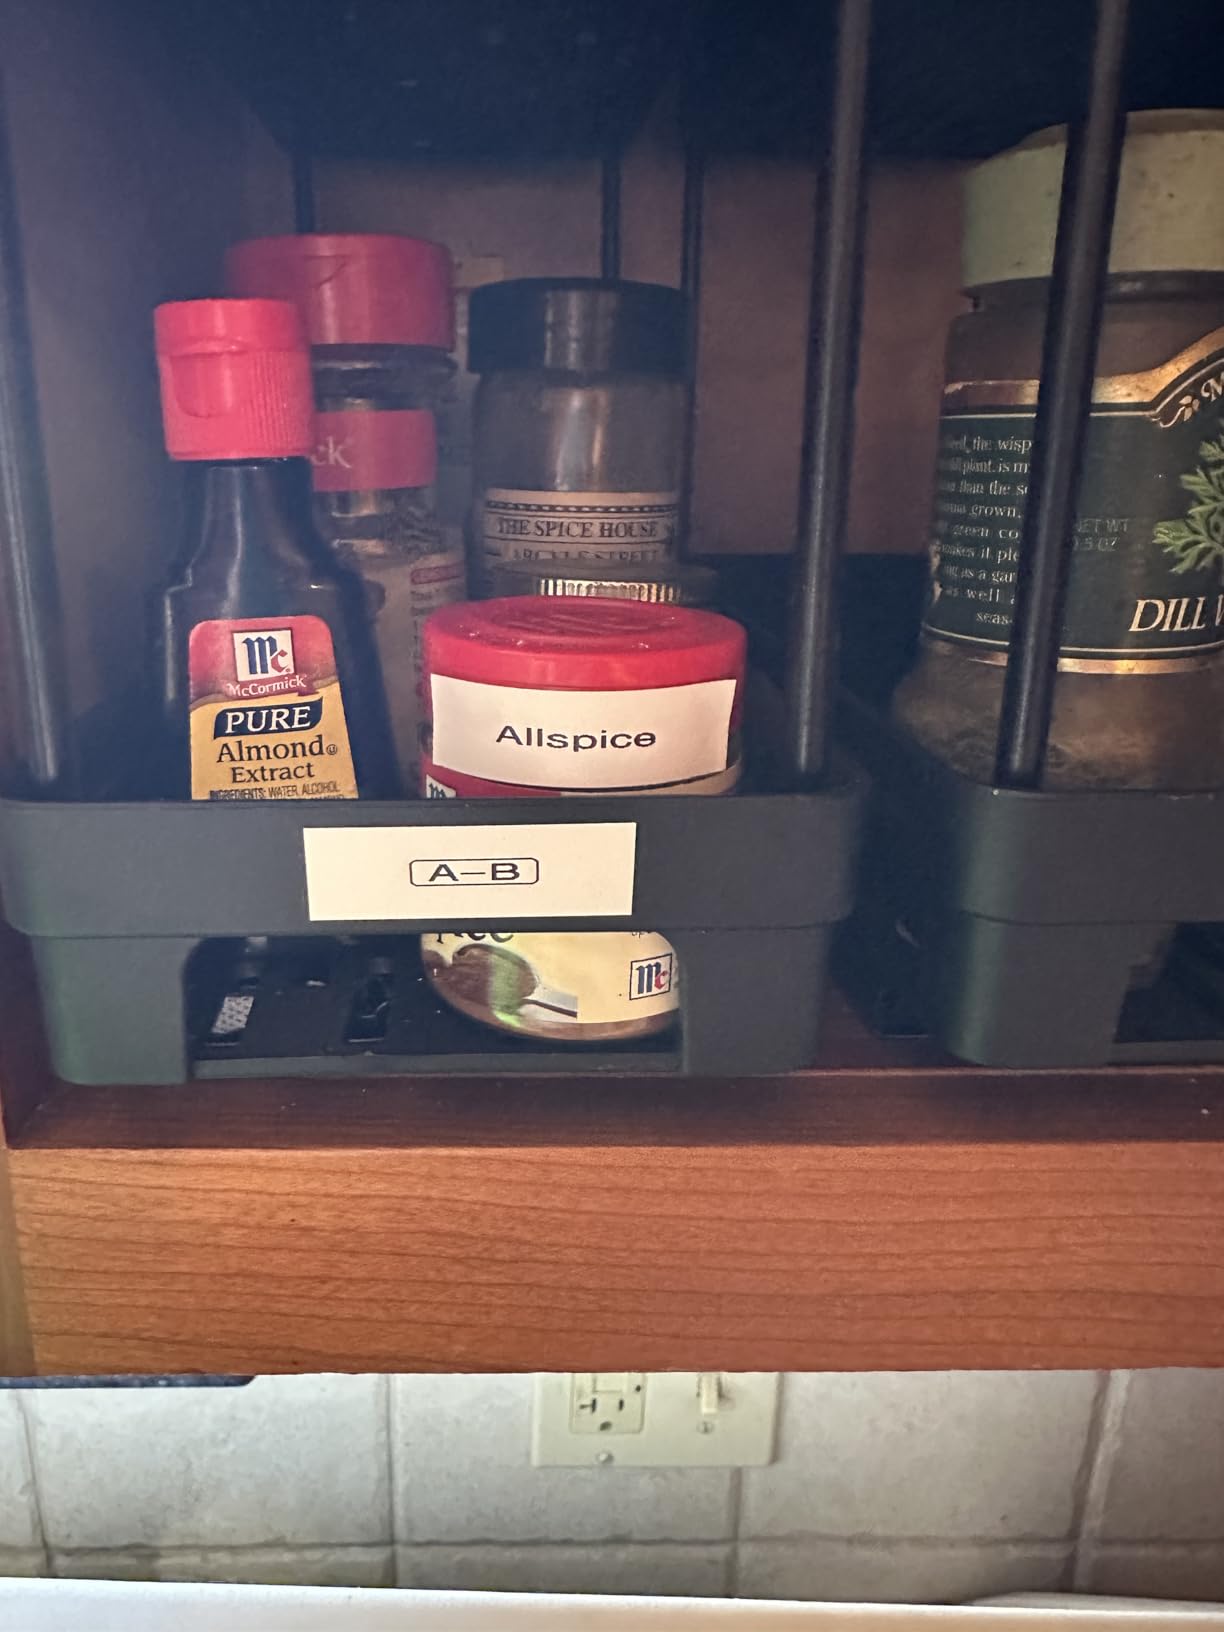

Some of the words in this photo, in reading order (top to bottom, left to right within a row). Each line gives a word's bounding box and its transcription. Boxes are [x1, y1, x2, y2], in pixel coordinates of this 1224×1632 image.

[999, 459, 1010, 473] is
[989, 481, 1011, 495] the
[499, 518, 530, 535] THE
[535, 519, 593, 538] SPICE
[599, 520, 659, 538] HOUSE
[1128, 596, 1206, 632] DILL
[226, 675, 307, 697] McCormick
[224, 705, 312, 734] PURE
[216, 734, 325, 763] Almond
[496, 725, 657, 752] Allspice
[231, 762, 316, 784] Extract
